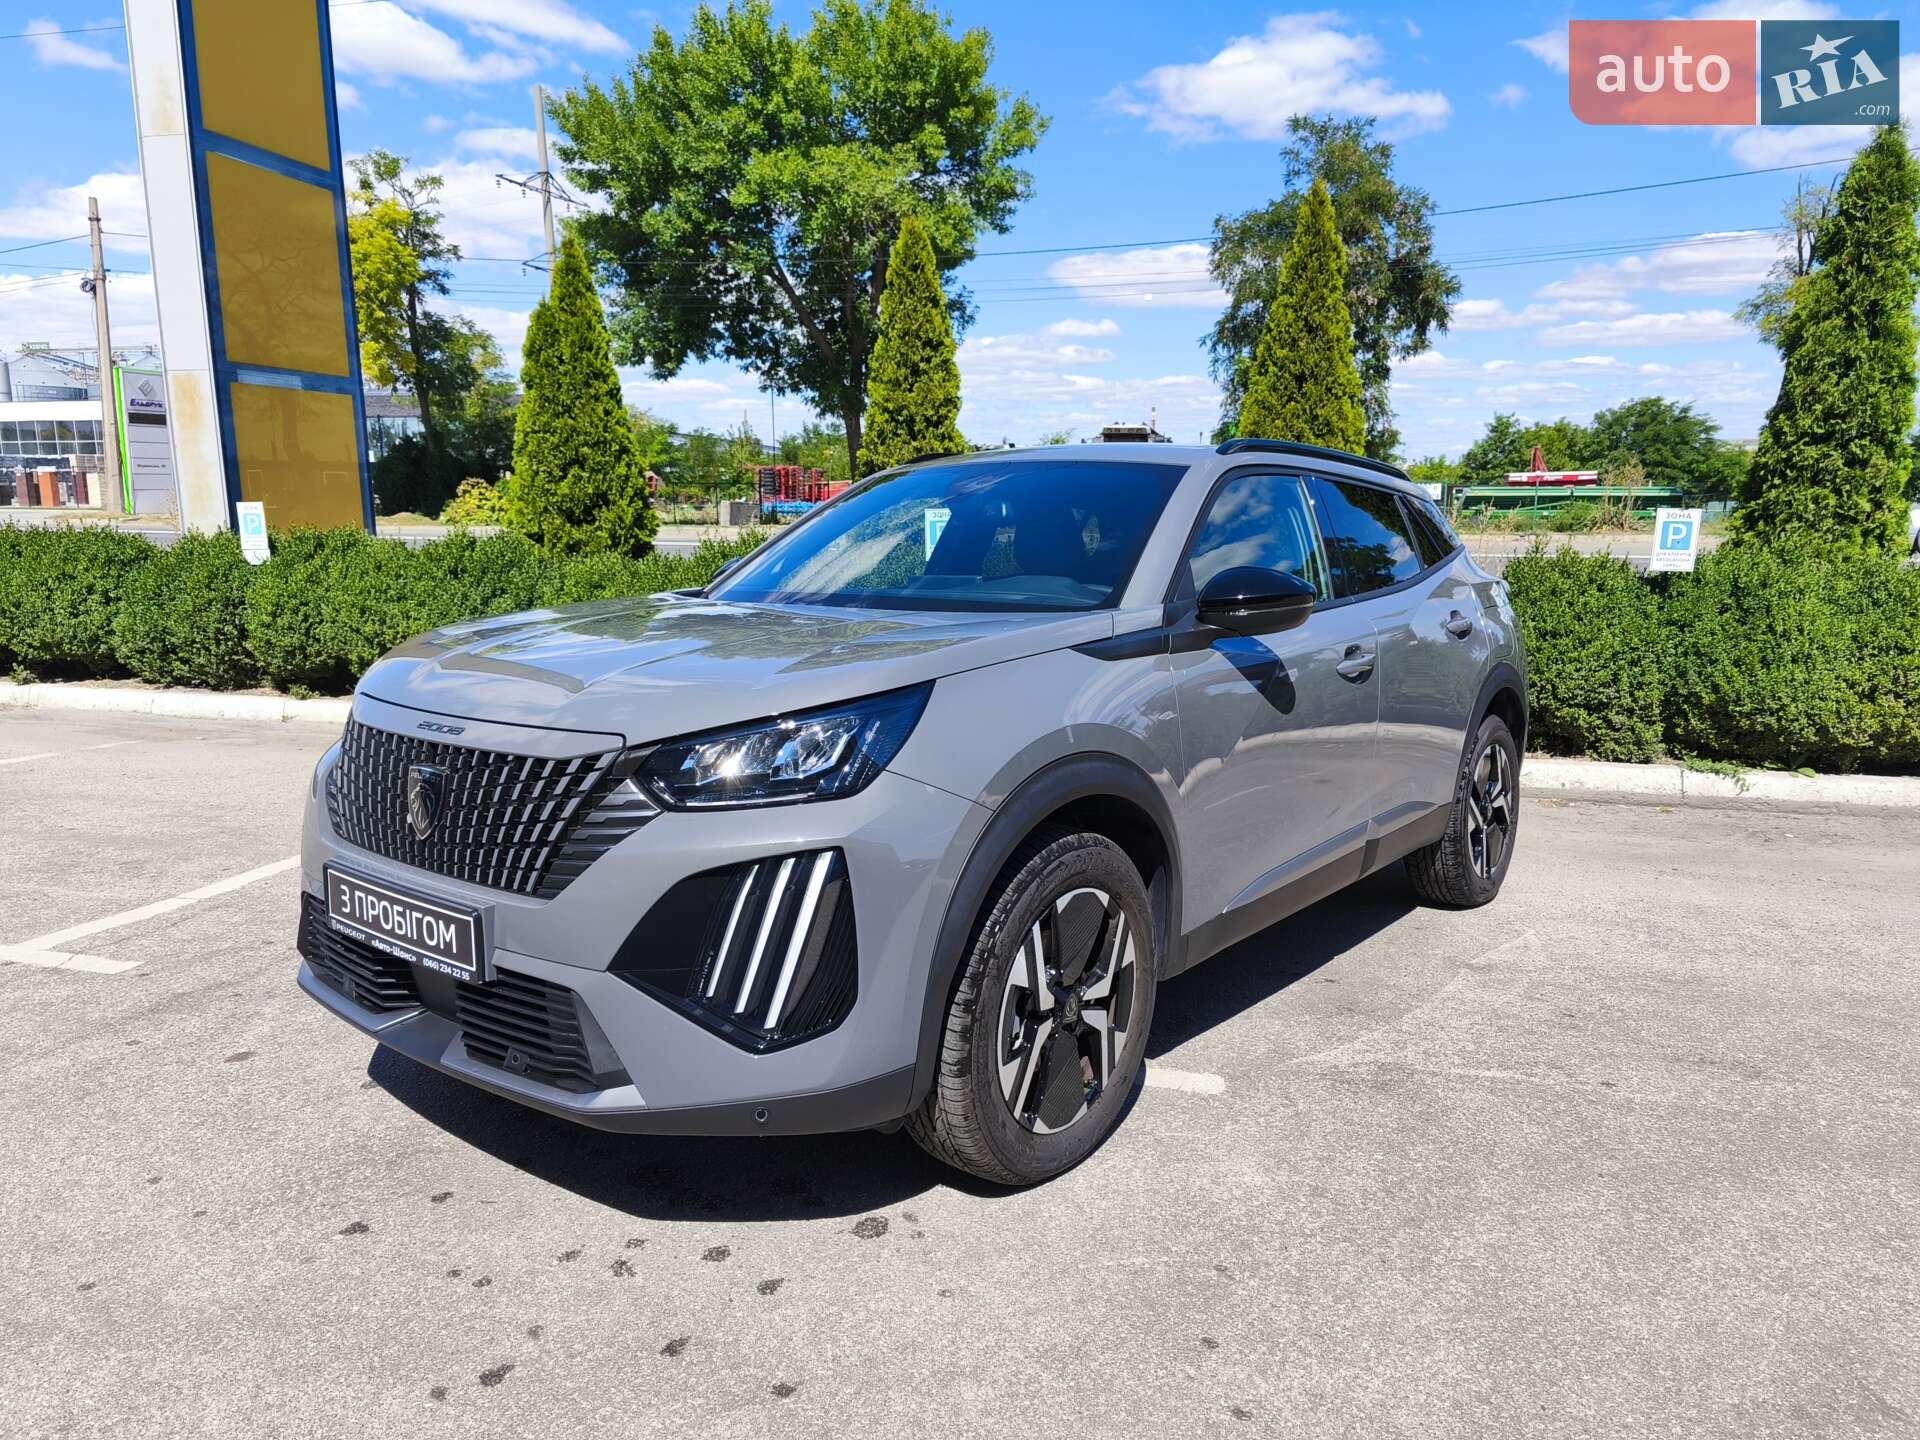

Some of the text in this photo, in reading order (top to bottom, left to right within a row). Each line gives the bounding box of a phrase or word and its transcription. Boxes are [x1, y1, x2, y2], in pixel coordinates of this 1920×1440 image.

[1665, 512, 1692, 520] ЗОНА
[1667, 523, 1687, 548] P
[417, 721, 466, 736] 2008
[340, 884, 457, 954] З ПРОБІГОМ
[336, 923, 366, 941] PEUGEOT
[452, 967, 462, 978] 22
[461, 971, 470, 981] 55
